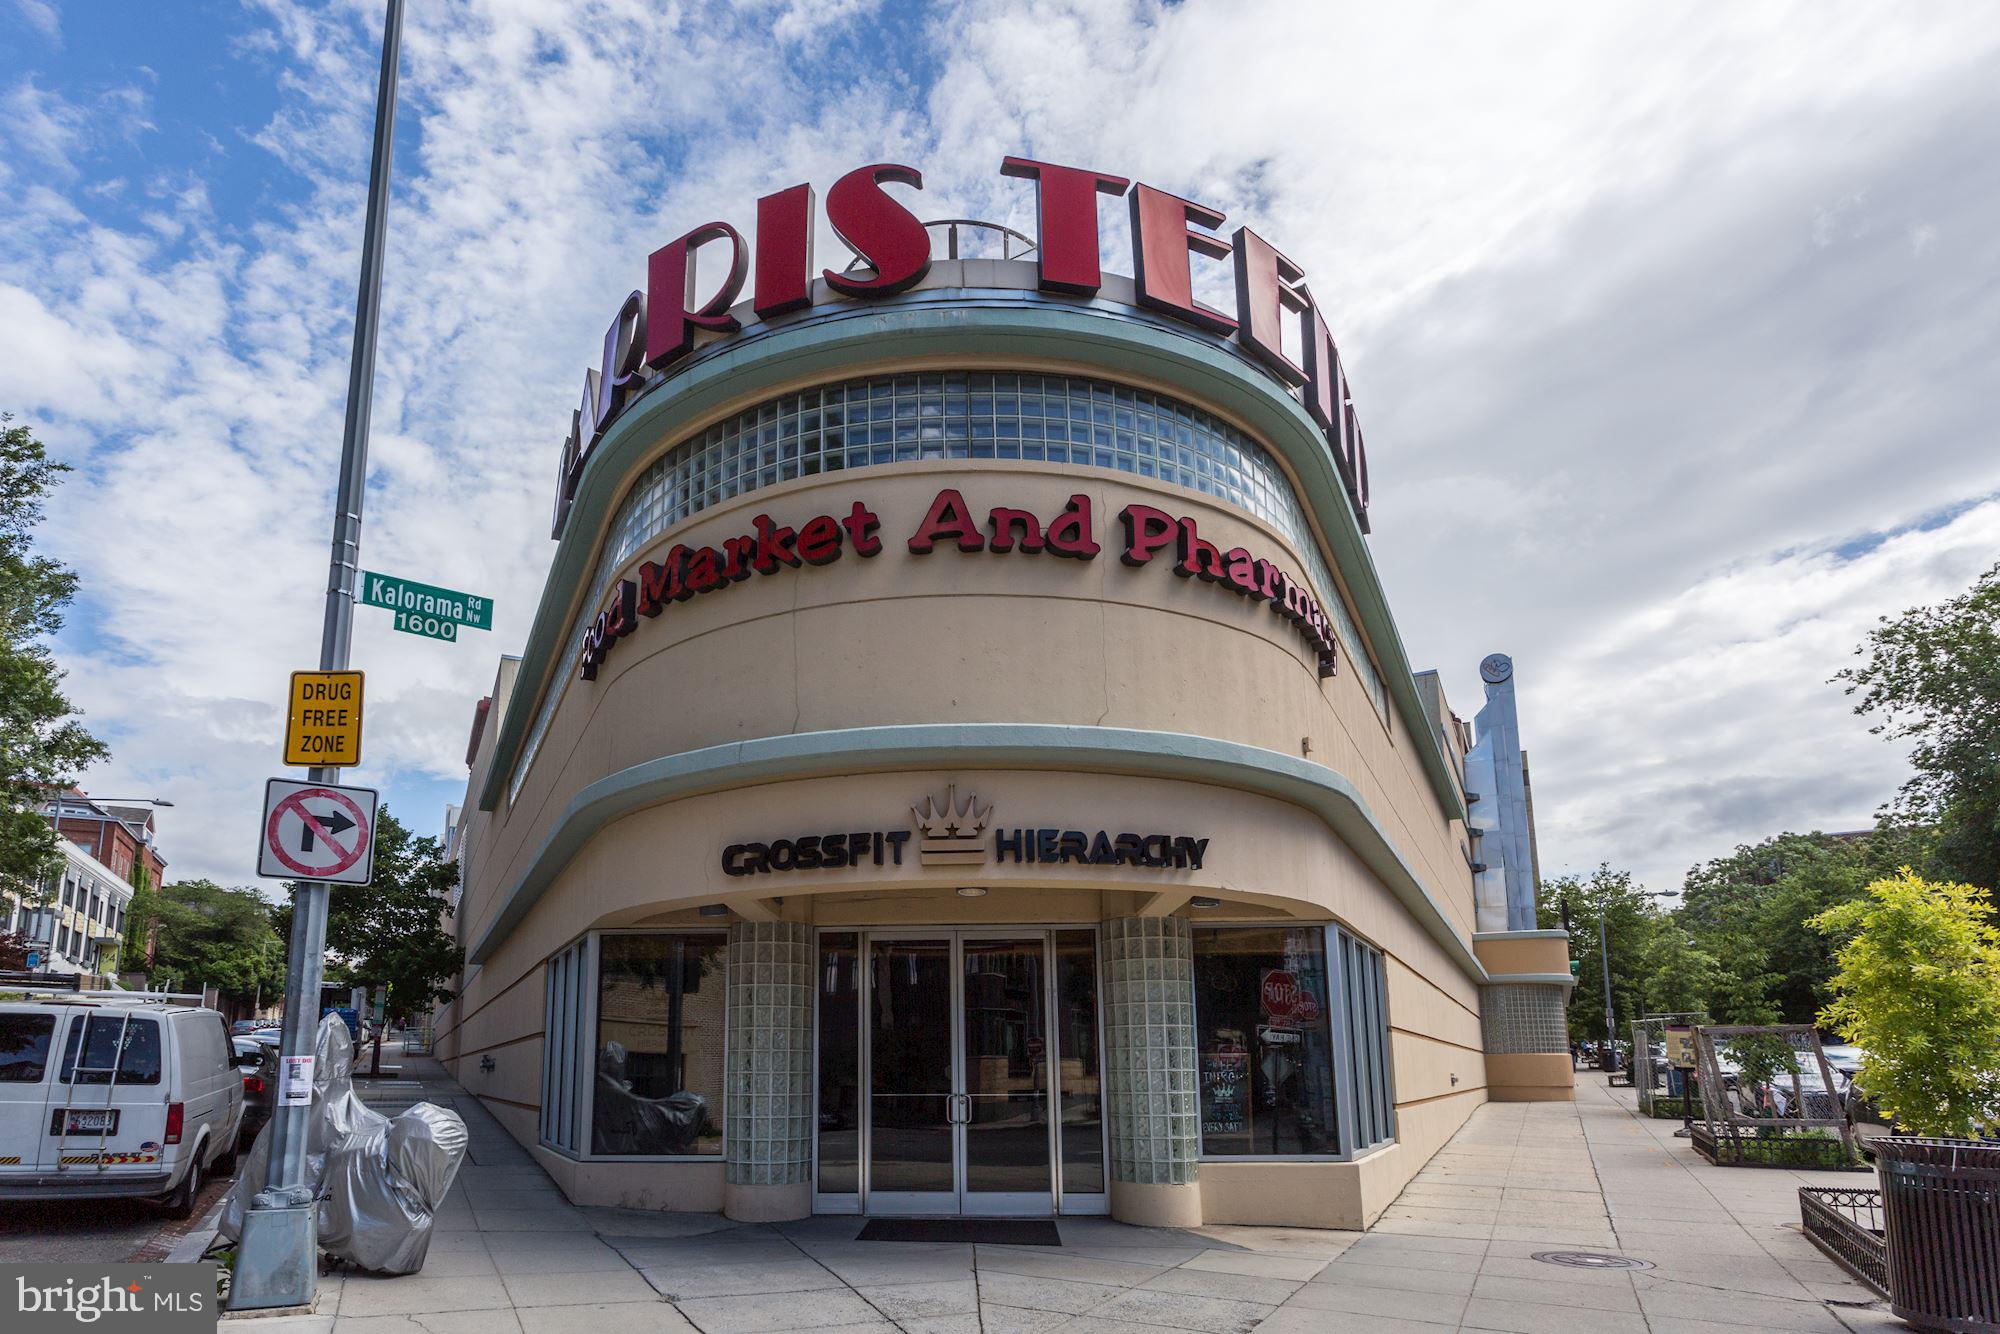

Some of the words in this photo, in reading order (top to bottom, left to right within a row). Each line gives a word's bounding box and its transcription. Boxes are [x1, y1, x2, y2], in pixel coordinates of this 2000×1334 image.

[638, 501, 883, 618] Market
[907, 489, 1101, 560] And
[371, 577, 463, 620] Kalorama
[468, 596, 481, 610] Rd
[398, 612, 455, 639] 1600
[303, 683, 351, 700] DRUG
[302, 709, 347, 726] FREE
[301, 735, 344, 753] ZONE
[721, 830, 911, 876] CROSSFIT
[995, 828, 1210, 870] HIERARCHY
